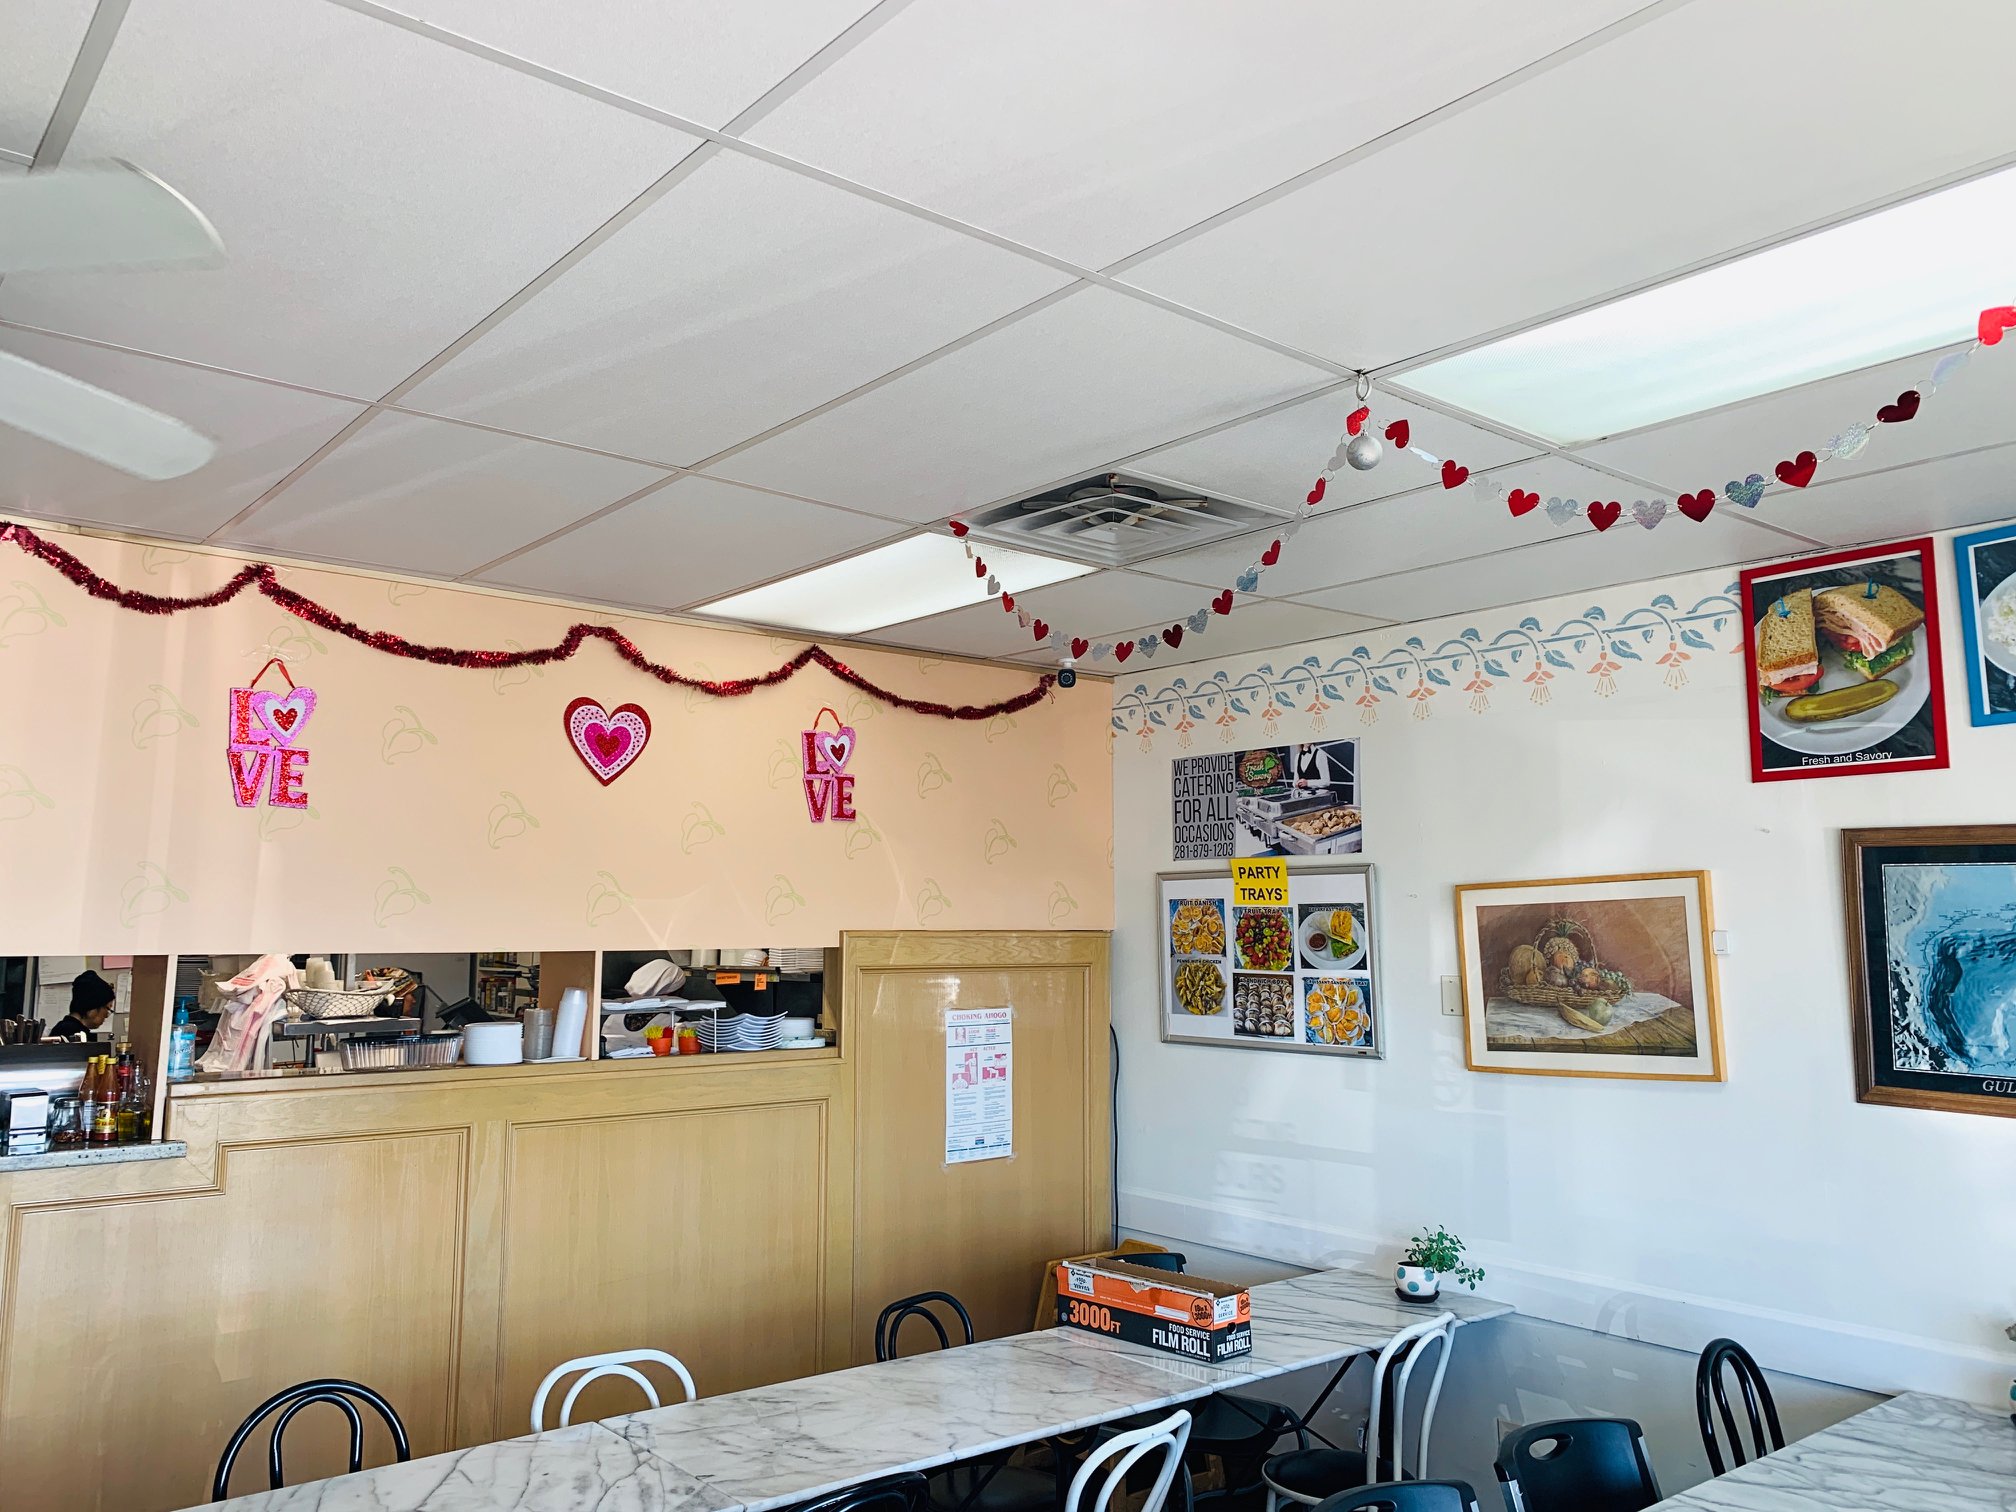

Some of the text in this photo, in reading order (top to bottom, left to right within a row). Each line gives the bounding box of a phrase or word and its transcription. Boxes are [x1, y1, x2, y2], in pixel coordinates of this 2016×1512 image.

[1174, 754, 1234, 776] WE PROVIDE
[1246, 760, 1265, 771] Fresh
[1802, 752, 1892, 765] Fresh and Savory
[1248, 770, 1272, 784] Savory
[1174, 773, 1234, 798] CATERING
[1174, 796, 1234, 824] FOR ALL
[1174, 822, 1234, 843] OCCASIONS
[1174, 842, 1234, 858] 281-879-1203
[1238, 866, 1280, 879] PARTY
[1240, 888, 1282, 900] TRAYS
[952, 1013, 982, 1021] CHOKING
[1169, 1324, 1210, 1340] FOOD SERVICE
[1152, 1328, 1178, 1349] FILM
[1181, 1335, 1210, 1357] ROLL
[1217, 1341, 1234, 1356] FILM
[1234, 1337, 1250, 1351] ROLL
